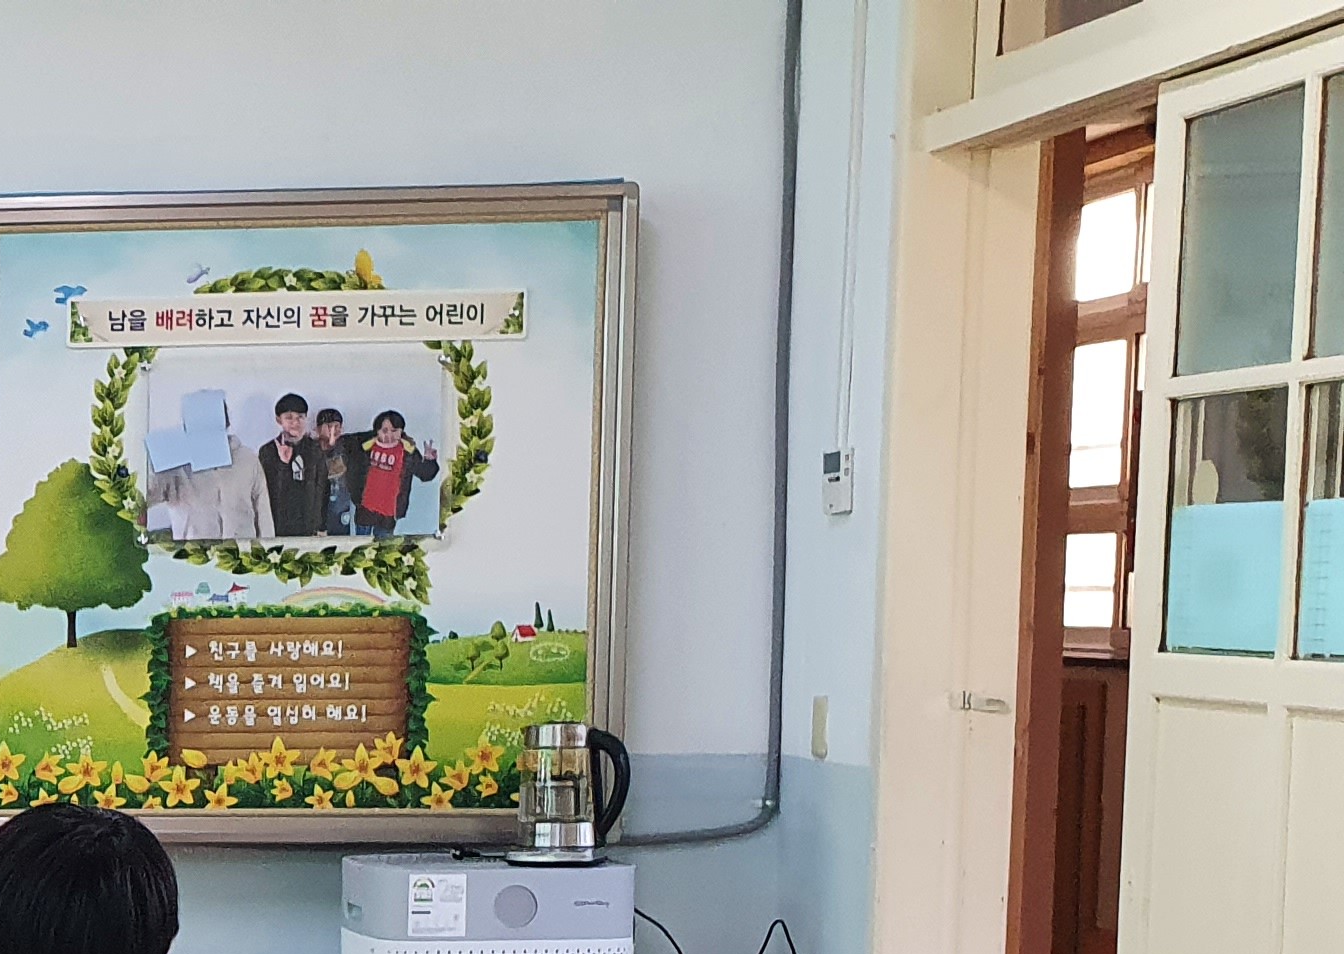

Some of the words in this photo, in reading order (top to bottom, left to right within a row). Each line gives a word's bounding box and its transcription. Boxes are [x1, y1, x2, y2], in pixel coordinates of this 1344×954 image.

[108, 307, 147, 332] 남을
[155, 307, 234, 331] 배려하고
[242, 305, 301, 330] 자신의
[309, 305, 349, 328] 꿈을
[357, 304, 417, 328] 가꾸는
[425, 302, 484, 326] 어린이
[208, 704, 257, 726] 운동을
